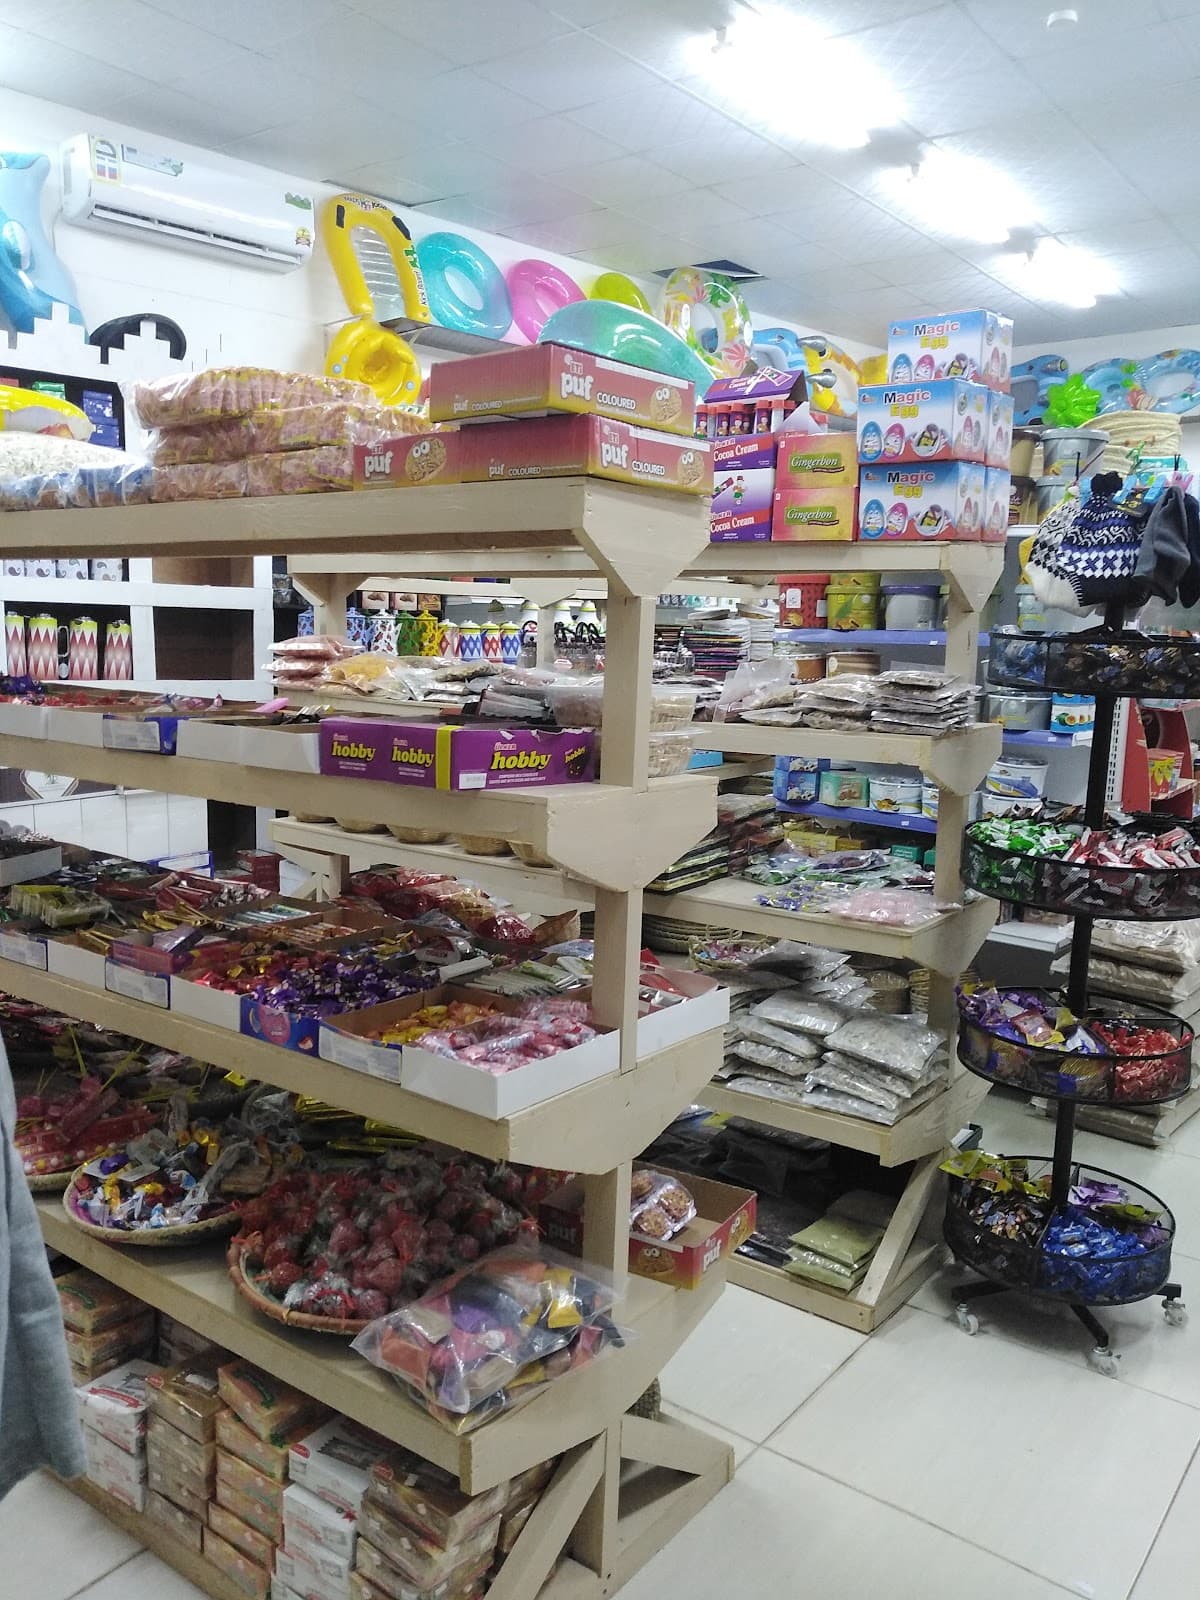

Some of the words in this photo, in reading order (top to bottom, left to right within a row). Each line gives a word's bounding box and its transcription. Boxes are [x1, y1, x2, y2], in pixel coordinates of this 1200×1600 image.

[914, 320, 960, 336] Magic
[920, 336, 949, 350] Egg
[560, 372, 594, 401] puf
[596, 392, 637, 410] COLOURED
[884, 389, 931, 404] Magic
[890, 404, 920, 419] Egg
[601, 442, 629, 468] puf
[713, 449, 735, 462] Cocoa
[735, 443, 759, 457] Cream
[364, 450, 394, 478] puf
[631, 460, 665, 476] COLOURED
[791, 456, 839, 469] Gingerbon
[887, 470, 935, 485] Magic
[893, 483, 923, 499] Egg
[786, 508, 833, 522] Gingerbon
[710, 520, 731, 534] Cocoa
[731, 516, 755, 529] Cream
[332, 741, 376, 761] hobby
[391, 746, 434, 767] hobby
[490, 751, 552, 770] hobby
[703, 1239, 722, 1273] puf
